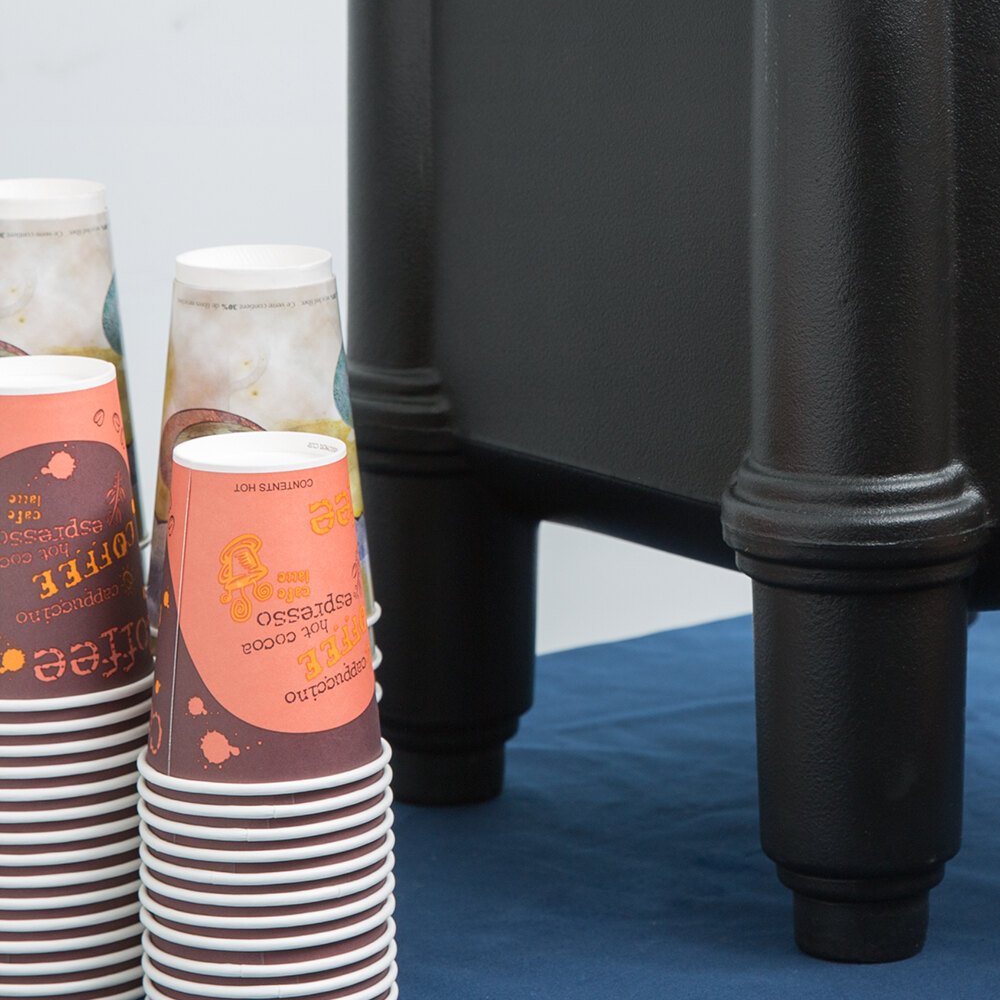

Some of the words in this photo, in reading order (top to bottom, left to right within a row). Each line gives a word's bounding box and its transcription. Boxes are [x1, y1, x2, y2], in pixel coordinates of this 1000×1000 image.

[221, 303, 238, 311] 30%
[234, 483, 256, 492] HOT
[259, 478, 314, 493] CONTENTS
[8, 494, 42, 507] latte
[8, 510, 42, 525] cafe
[32, 520, 136, 600] COFFEE
[40, 543, 70, 560] hot
[277, 570, 310, 583] latte
[16, 583, 120, 624] cappuccino
[277, 586, 311, 604] cafe
[256, 592, 353, 627] espresso
[304, 618, 329, 639] hot
[242, 631, 297, 655] cocoa
[284, 655, 367, 704] cappuccino
